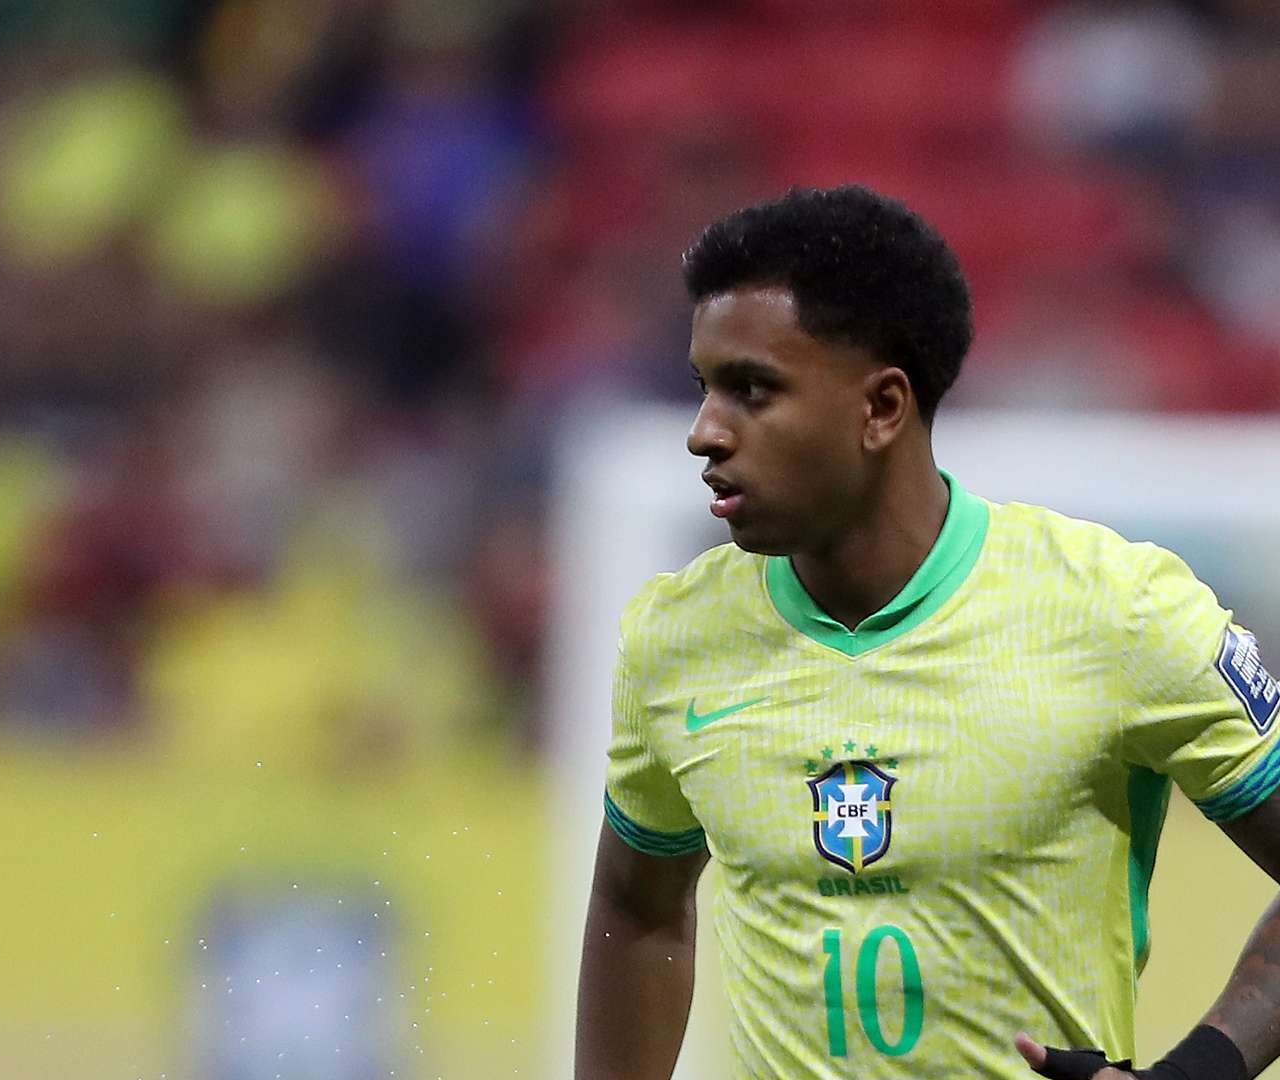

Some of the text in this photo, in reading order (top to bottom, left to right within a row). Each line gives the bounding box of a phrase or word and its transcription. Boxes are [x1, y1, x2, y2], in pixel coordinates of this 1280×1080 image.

[837, 804, 869, 818] CBF
[817, 875, 910, 897] BRASIL
[822, 923, 925, 1057] 10
